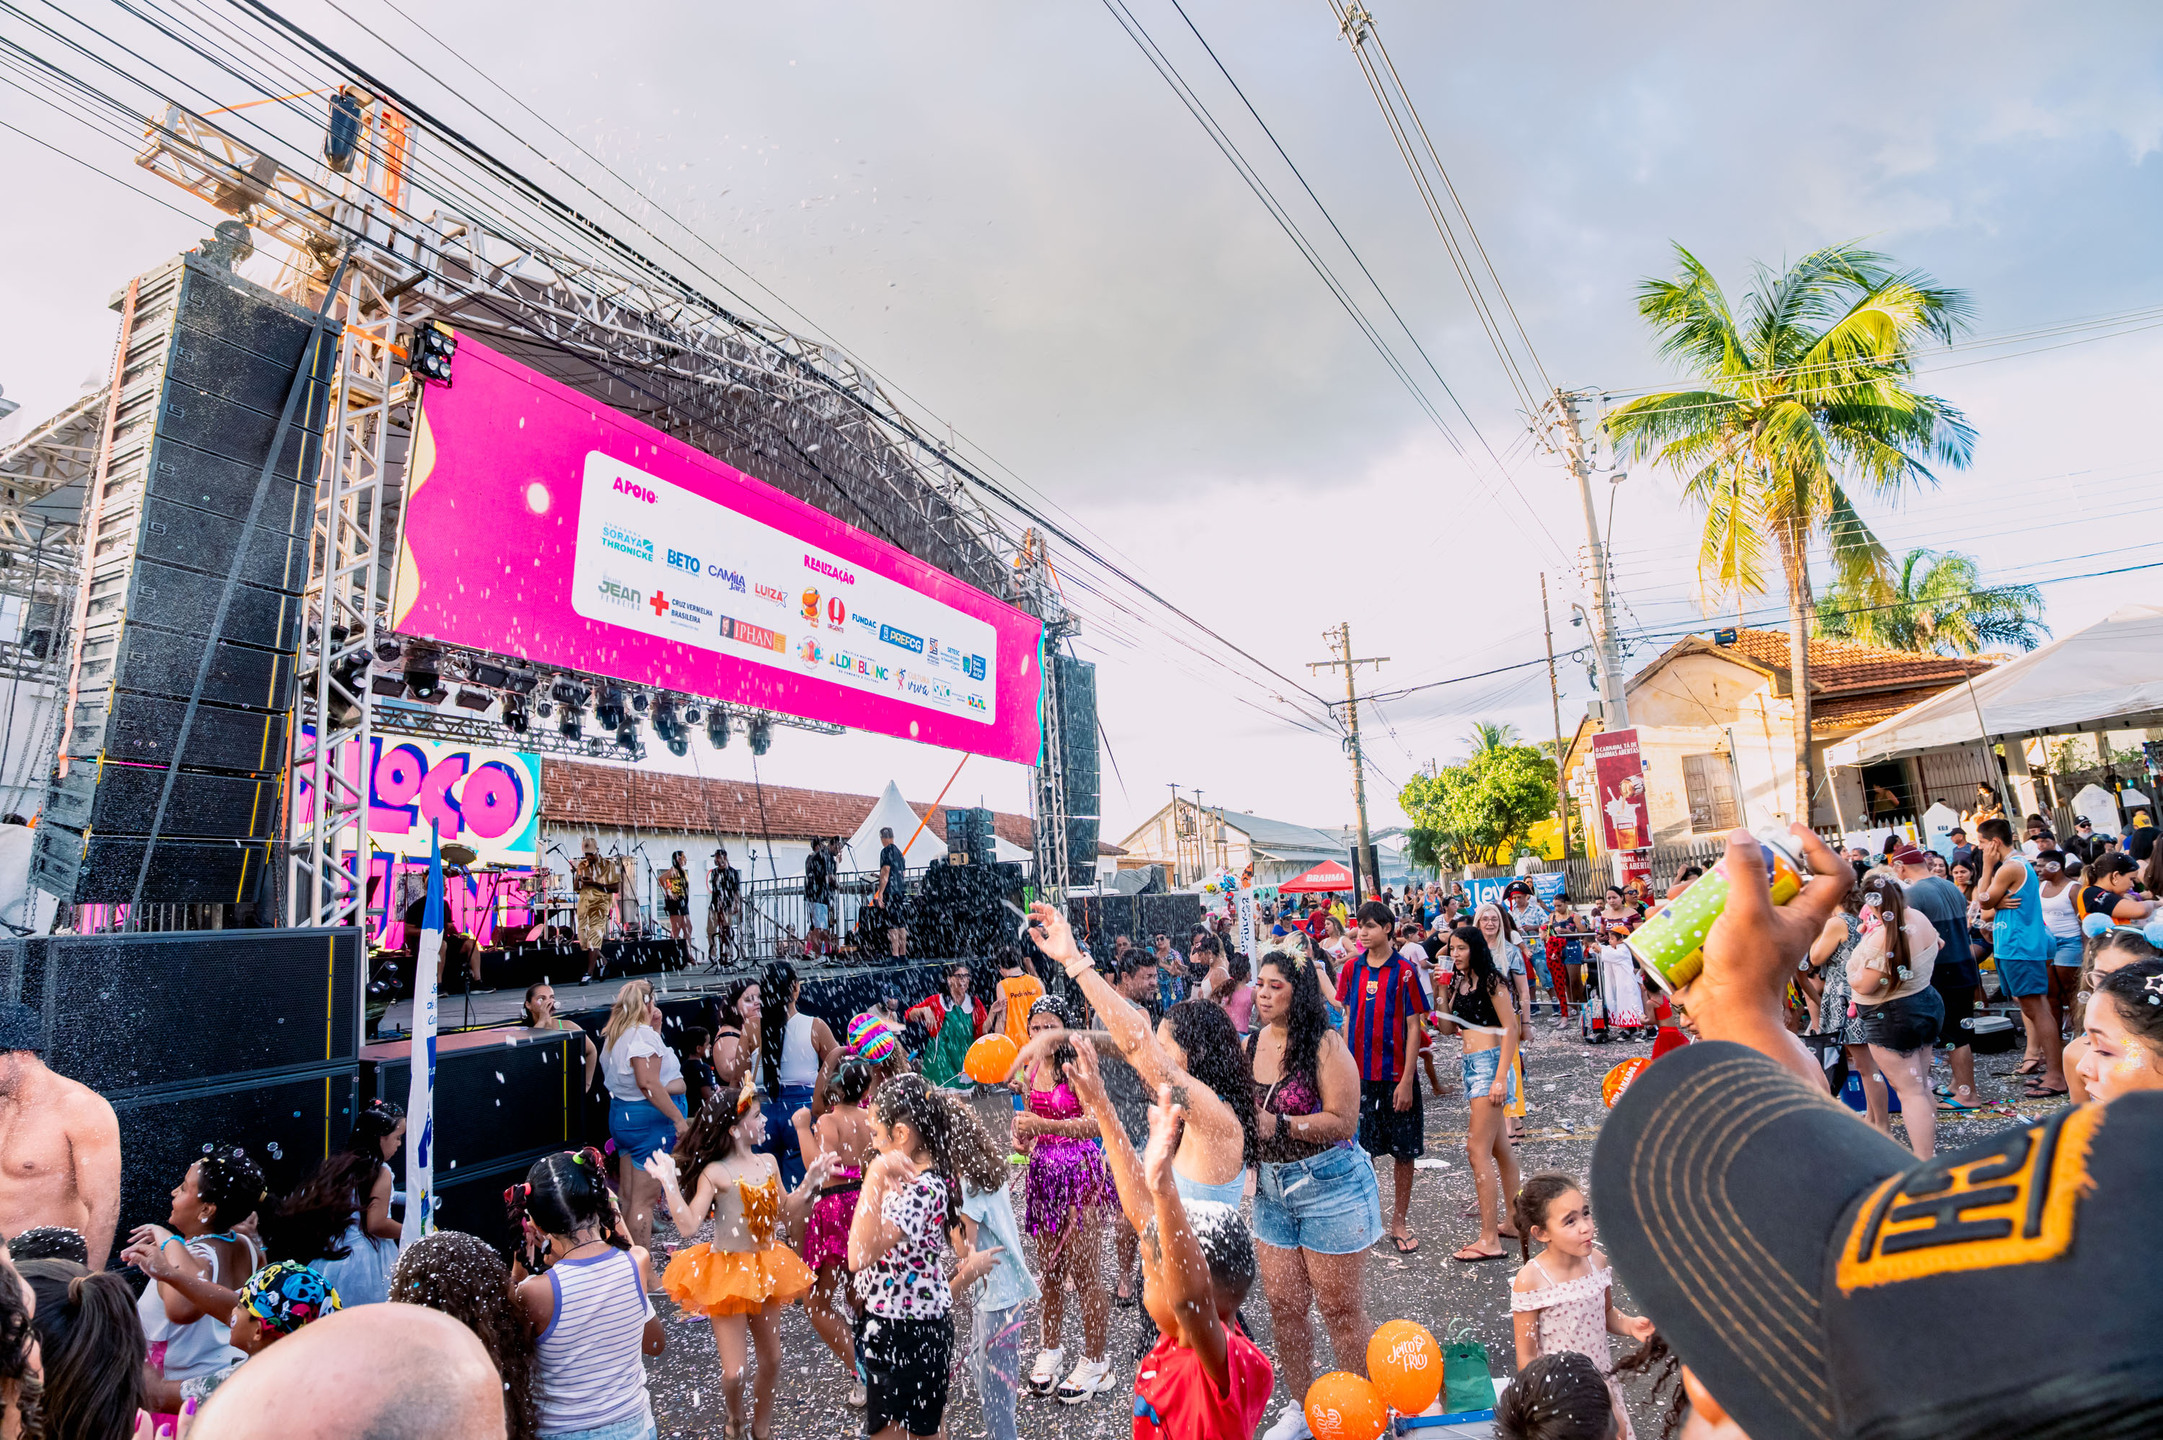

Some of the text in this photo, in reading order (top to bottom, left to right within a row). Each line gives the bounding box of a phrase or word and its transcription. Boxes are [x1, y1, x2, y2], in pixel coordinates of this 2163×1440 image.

[613, 476, 659, 504] APOIO:
[603, 526, 642, 548] SORAYA
[602, 537, 653, 562] THRONICKE
[667, 548, 700, 573] BETO
[804, 554, 855, 585] REALIZAÇÃO
[755, 583, 783, 602] LUIZA
[671, 598, 714, 617] CRUZ VERMELHA
[671, 609, 701, 624] BRASILEIRA
[852, 613, 877, 629] FUNDAC
[735, 622, 773, 647] IPHAN
[890, 630, 921, 651] PREFCG
[829, 653, 889, 681] ALDIR BLANC
[1618, 747, 1639, 756] ABERTAS
[1305, 872, 1345, 882] BRAHMA
